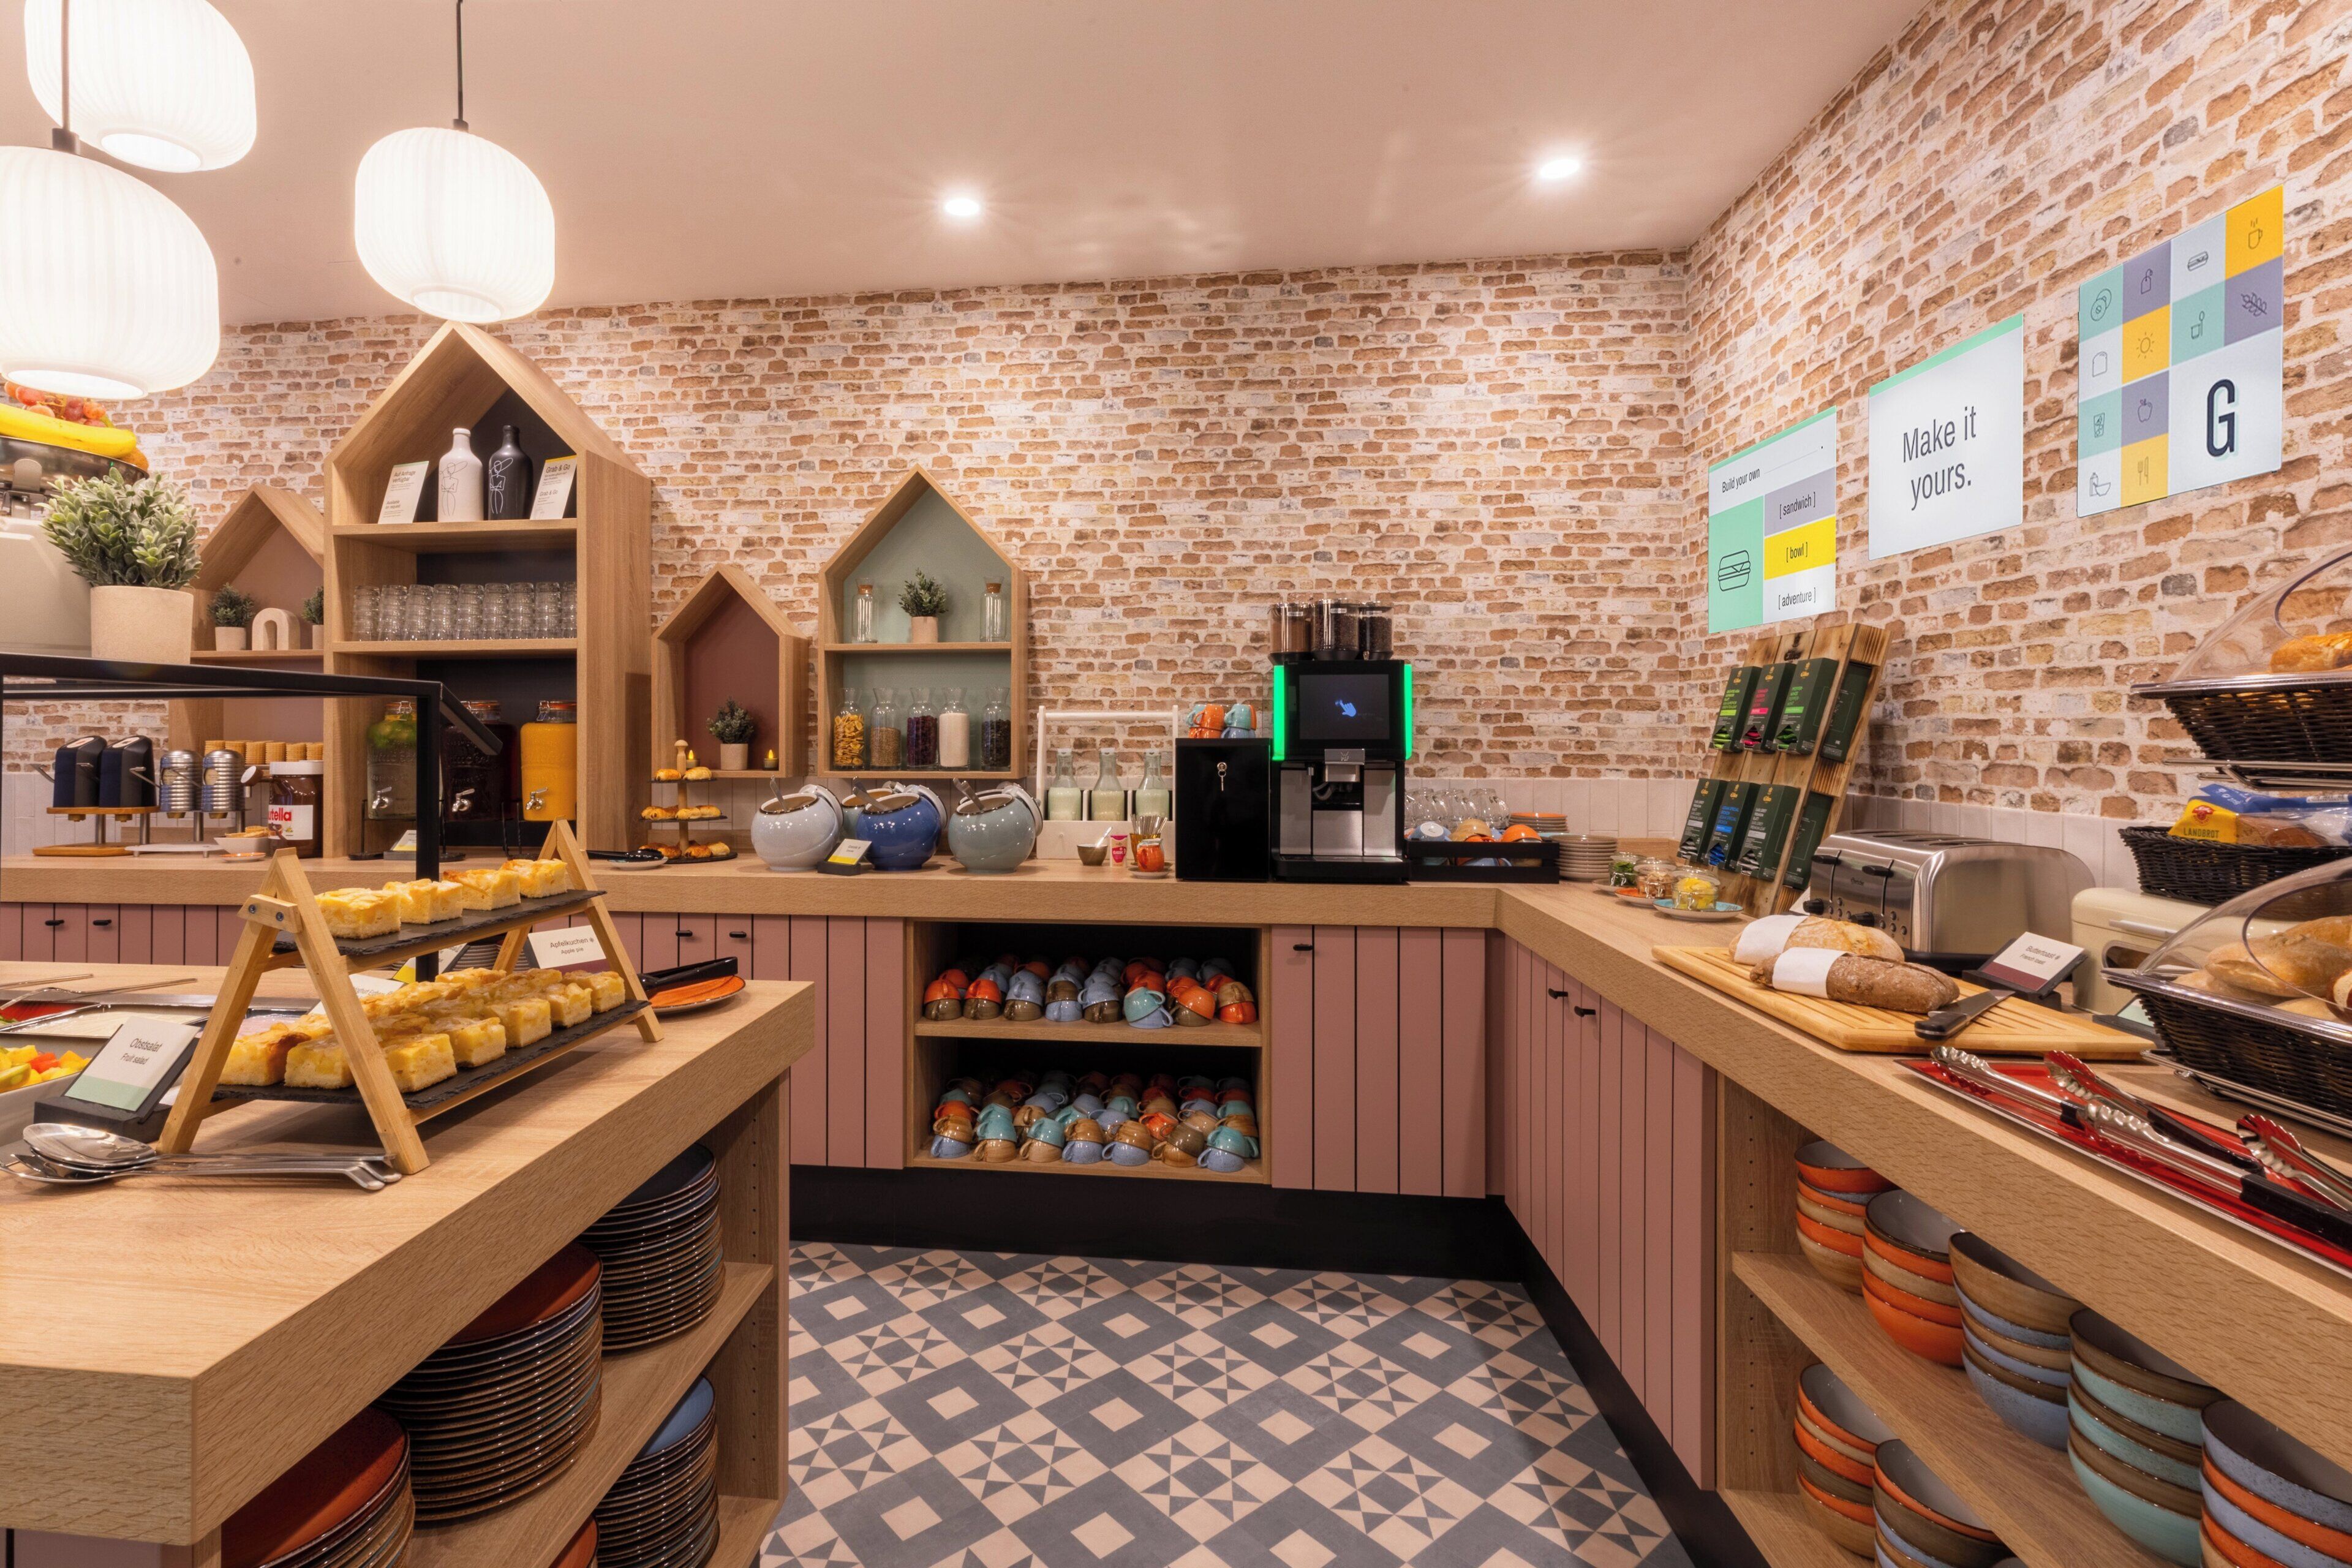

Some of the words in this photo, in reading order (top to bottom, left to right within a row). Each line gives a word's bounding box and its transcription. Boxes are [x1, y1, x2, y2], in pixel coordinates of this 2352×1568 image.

[2207, 379, 2236, 458] G
[1903, 418, 1956, 463] Make
[1964, 405, 1977, 441] it
[1722, 477, 1735, 493] Build
[1736, 473, 1747, 489] your
[1749, 468, 1760, 482] own
[1911, 462, 1971, 511] yours.
[1783, 494, 1812, 516] sandwich
[1790, 543, 1804, 559] bowl
[1782, 590, 1812, 607] adventure
[268, 807, 292, 821] utella
[2184, 827, 2219, 839] LANDBROT
[550, 938, 588, 949] Apfelkuchen
[130, 1038, 163, 1052] Obstsalat
[120, 1053, 134, 1062] Fruit
[132, 1056, 150, 1065] salad
